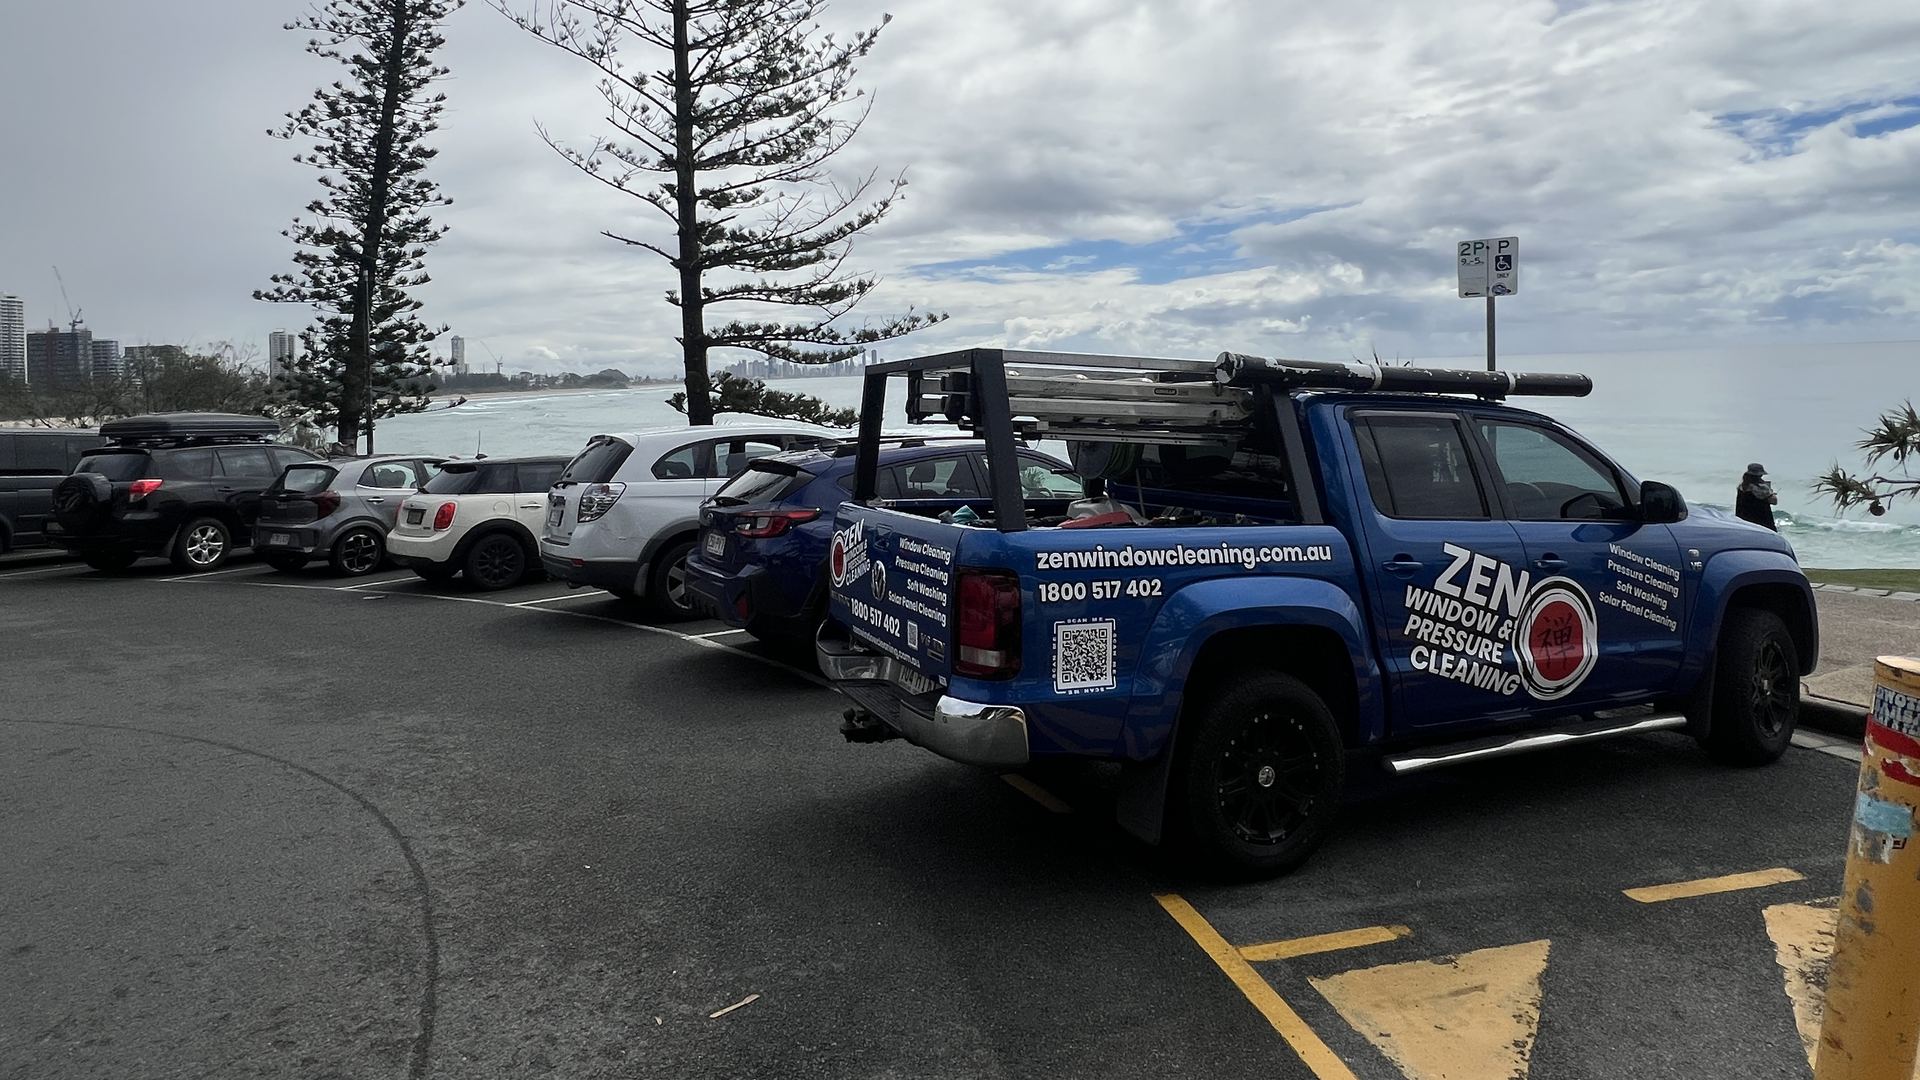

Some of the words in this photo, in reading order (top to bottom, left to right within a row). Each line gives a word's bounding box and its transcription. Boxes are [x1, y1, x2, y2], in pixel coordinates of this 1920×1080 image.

[1460, 242, 1484, 256] 2P
[1498, 240, 1509, 253] P
[844, 518, 865, 553] ZEN
[900, 537, 922, 554] Window
[922, 544, 951, 565] Cleaning
[895, 555, 920, 573] Pressure
[920, 563, 949, 586] Cleaning
[1037, 543, 1332, 569] zenwindowcleaning.com.au
[1609, 543, 1644, 564] Window
[1644, 557, 1680, 582] Cleaning
[907, 579, 919, 593] Soft
[920, 582, 947, 607] Washing
[1039, 582, 1087, 602] 1800
[1092, 580, 1121, 599] 517
[1126, 579, 1162, 598] 402
[1434, 542, 1530, 618] ZEN
[1607, 559, 1644, 581] Pressure
[1644, 574, 1679, 598] Cleaning
[1616, 580, 1633, 594] Soft
[1633, 586, 1668, 611] Washing
[851, 598, 869, 621] 1800
[869, 606, 882, 628] 517
[883, 614, 900, 637] 402
[888, 590, 902, 605] Solar
[902, 596, 918, 612] Panel
[918, 601, 947, 627] Cleaning
[1405, 585, 1499, 634] WINDOW
[1498, 620, 1512, 641] &
[1598, 591, 1621, 607] Solar
[1620, 599, 1644, 616] Panel
[1643, 608, 1678, 632] Cleaning
[1404, 614, 1504, 665] PRESSURE
[1410, 645, 1521, 696] CLEANING
